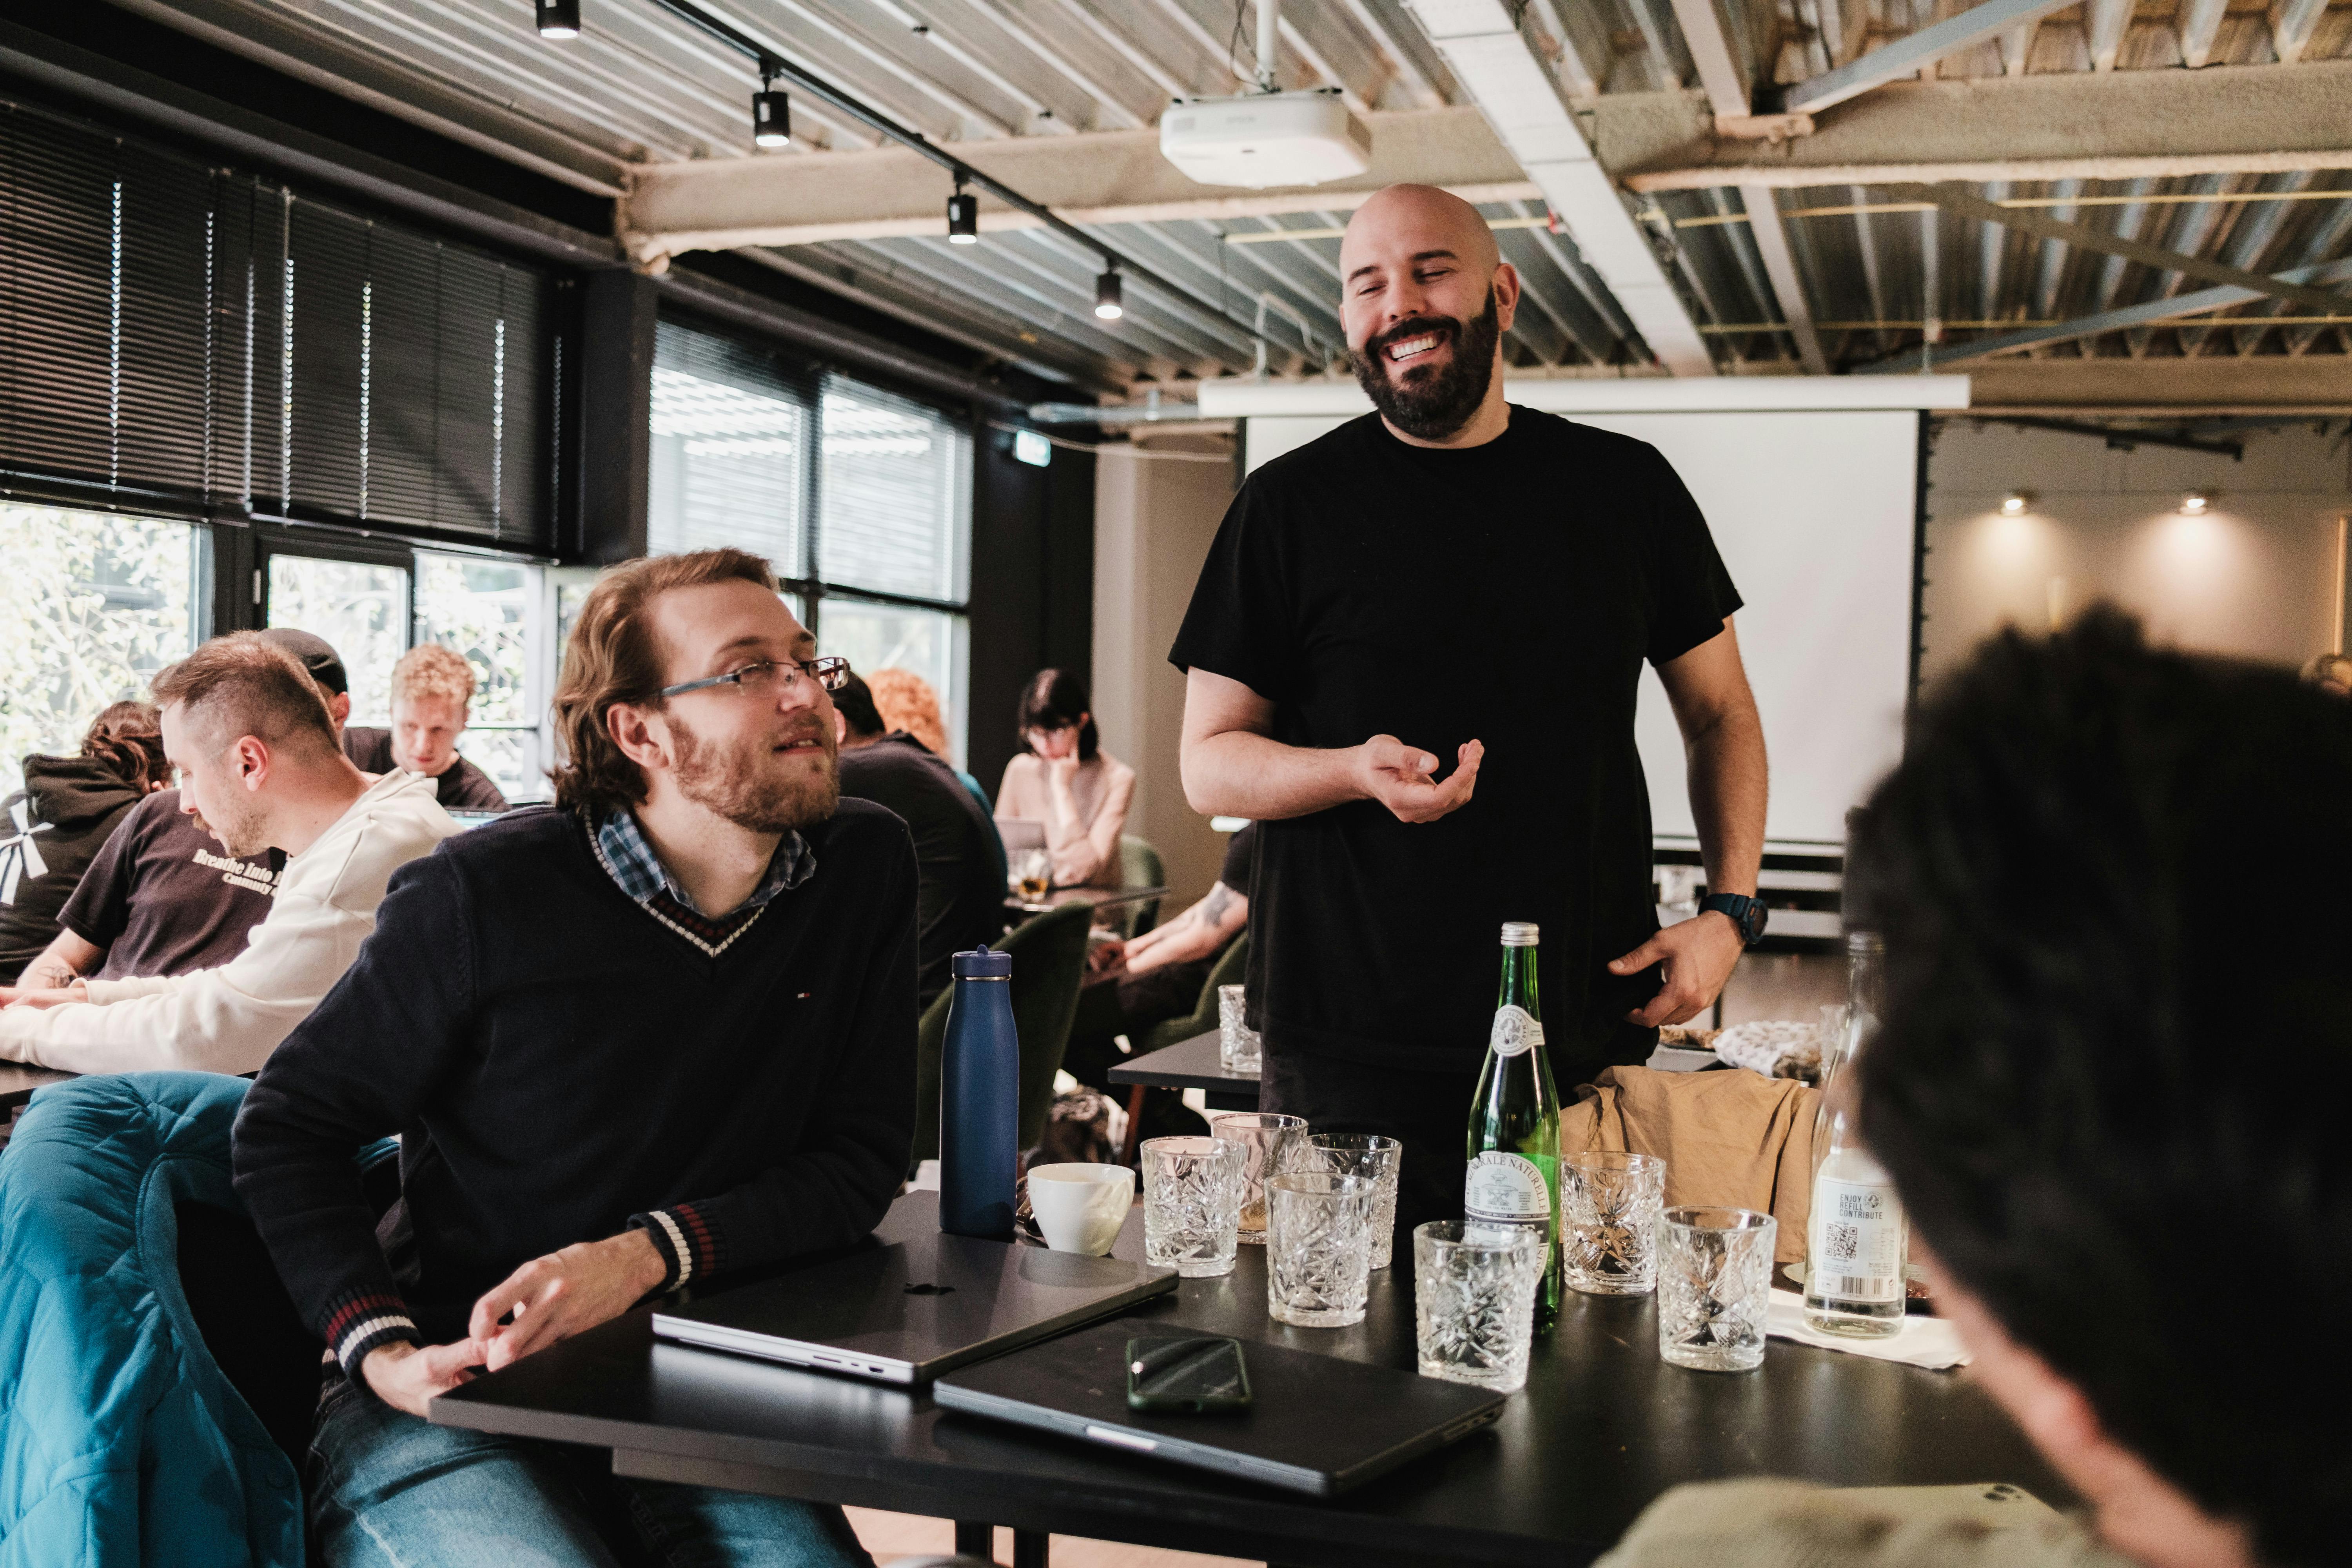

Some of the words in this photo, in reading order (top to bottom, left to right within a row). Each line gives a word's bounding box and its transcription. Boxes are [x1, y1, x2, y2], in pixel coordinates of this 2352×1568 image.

[192, 849, 245, 875] Breathe
[242, 862, 273, 882] Into
[1509, 1158, 1546, 1212] NATURELLE
[1840, 1194, 1862, 1203] ENJOY
[1840, 1201, 1863, 1210] REFILL
[1839, 1209, 1883, 1219] CONTRIBUTE
